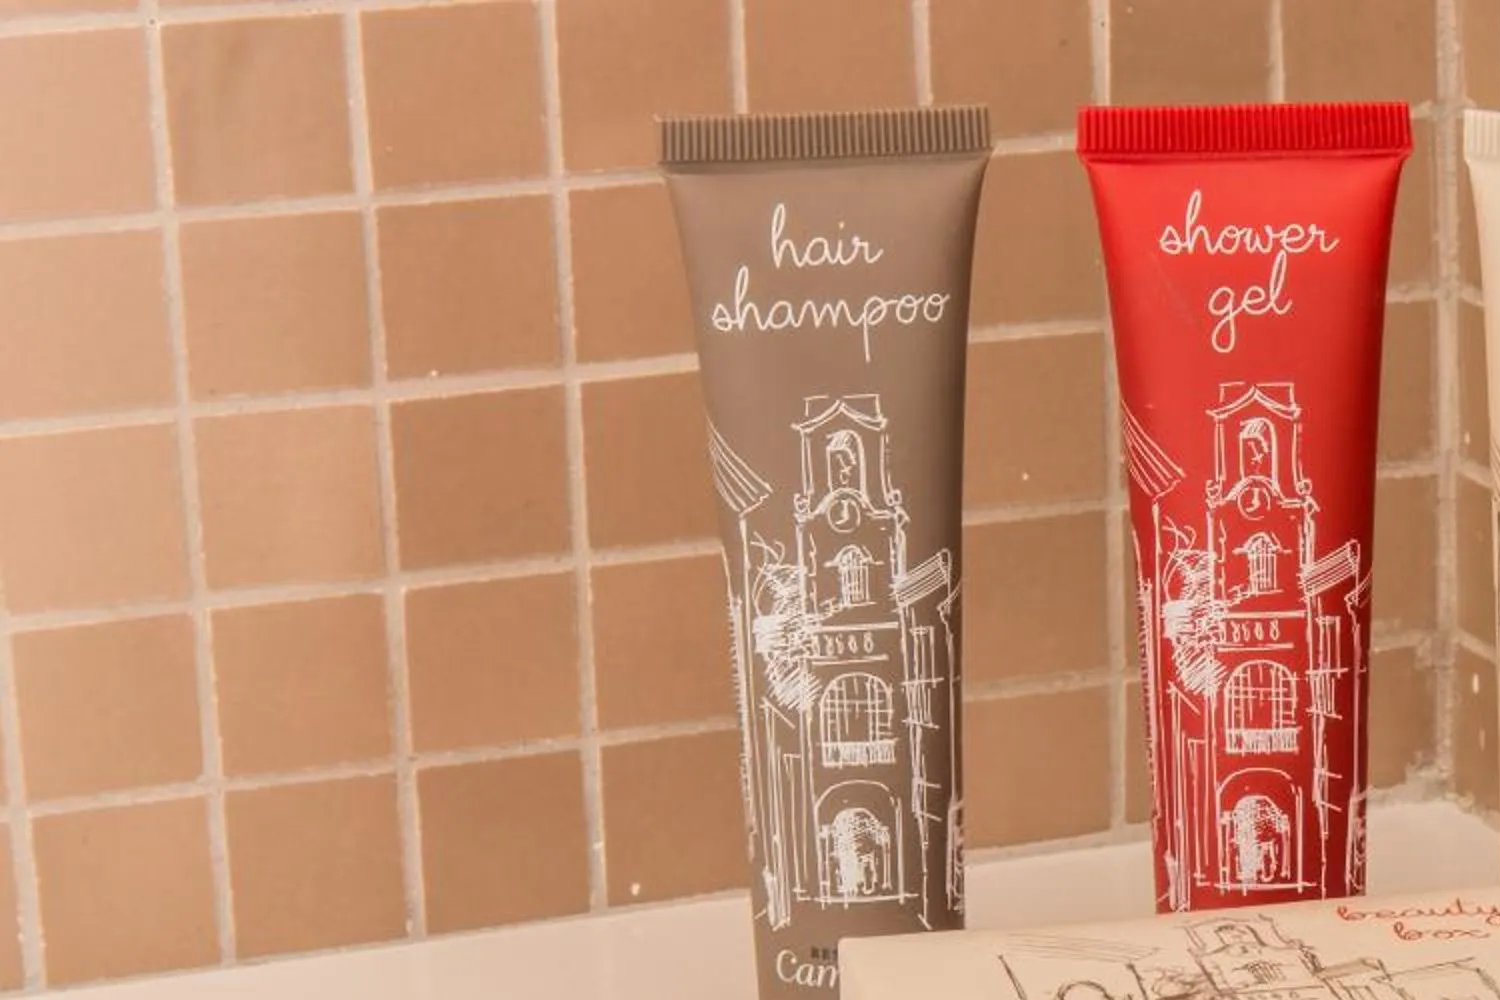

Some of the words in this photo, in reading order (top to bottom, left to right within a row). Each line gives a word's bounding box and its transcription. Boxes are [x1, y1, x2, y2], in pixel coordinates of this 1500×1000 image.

[771, 203, 883, 268] hair
[1159, 189, 1339, 255] shower
[711, 266, 950, 362] shampoo
[1208, 251, 1293, 352] gel
[1393, 920, 1490, 941] box
